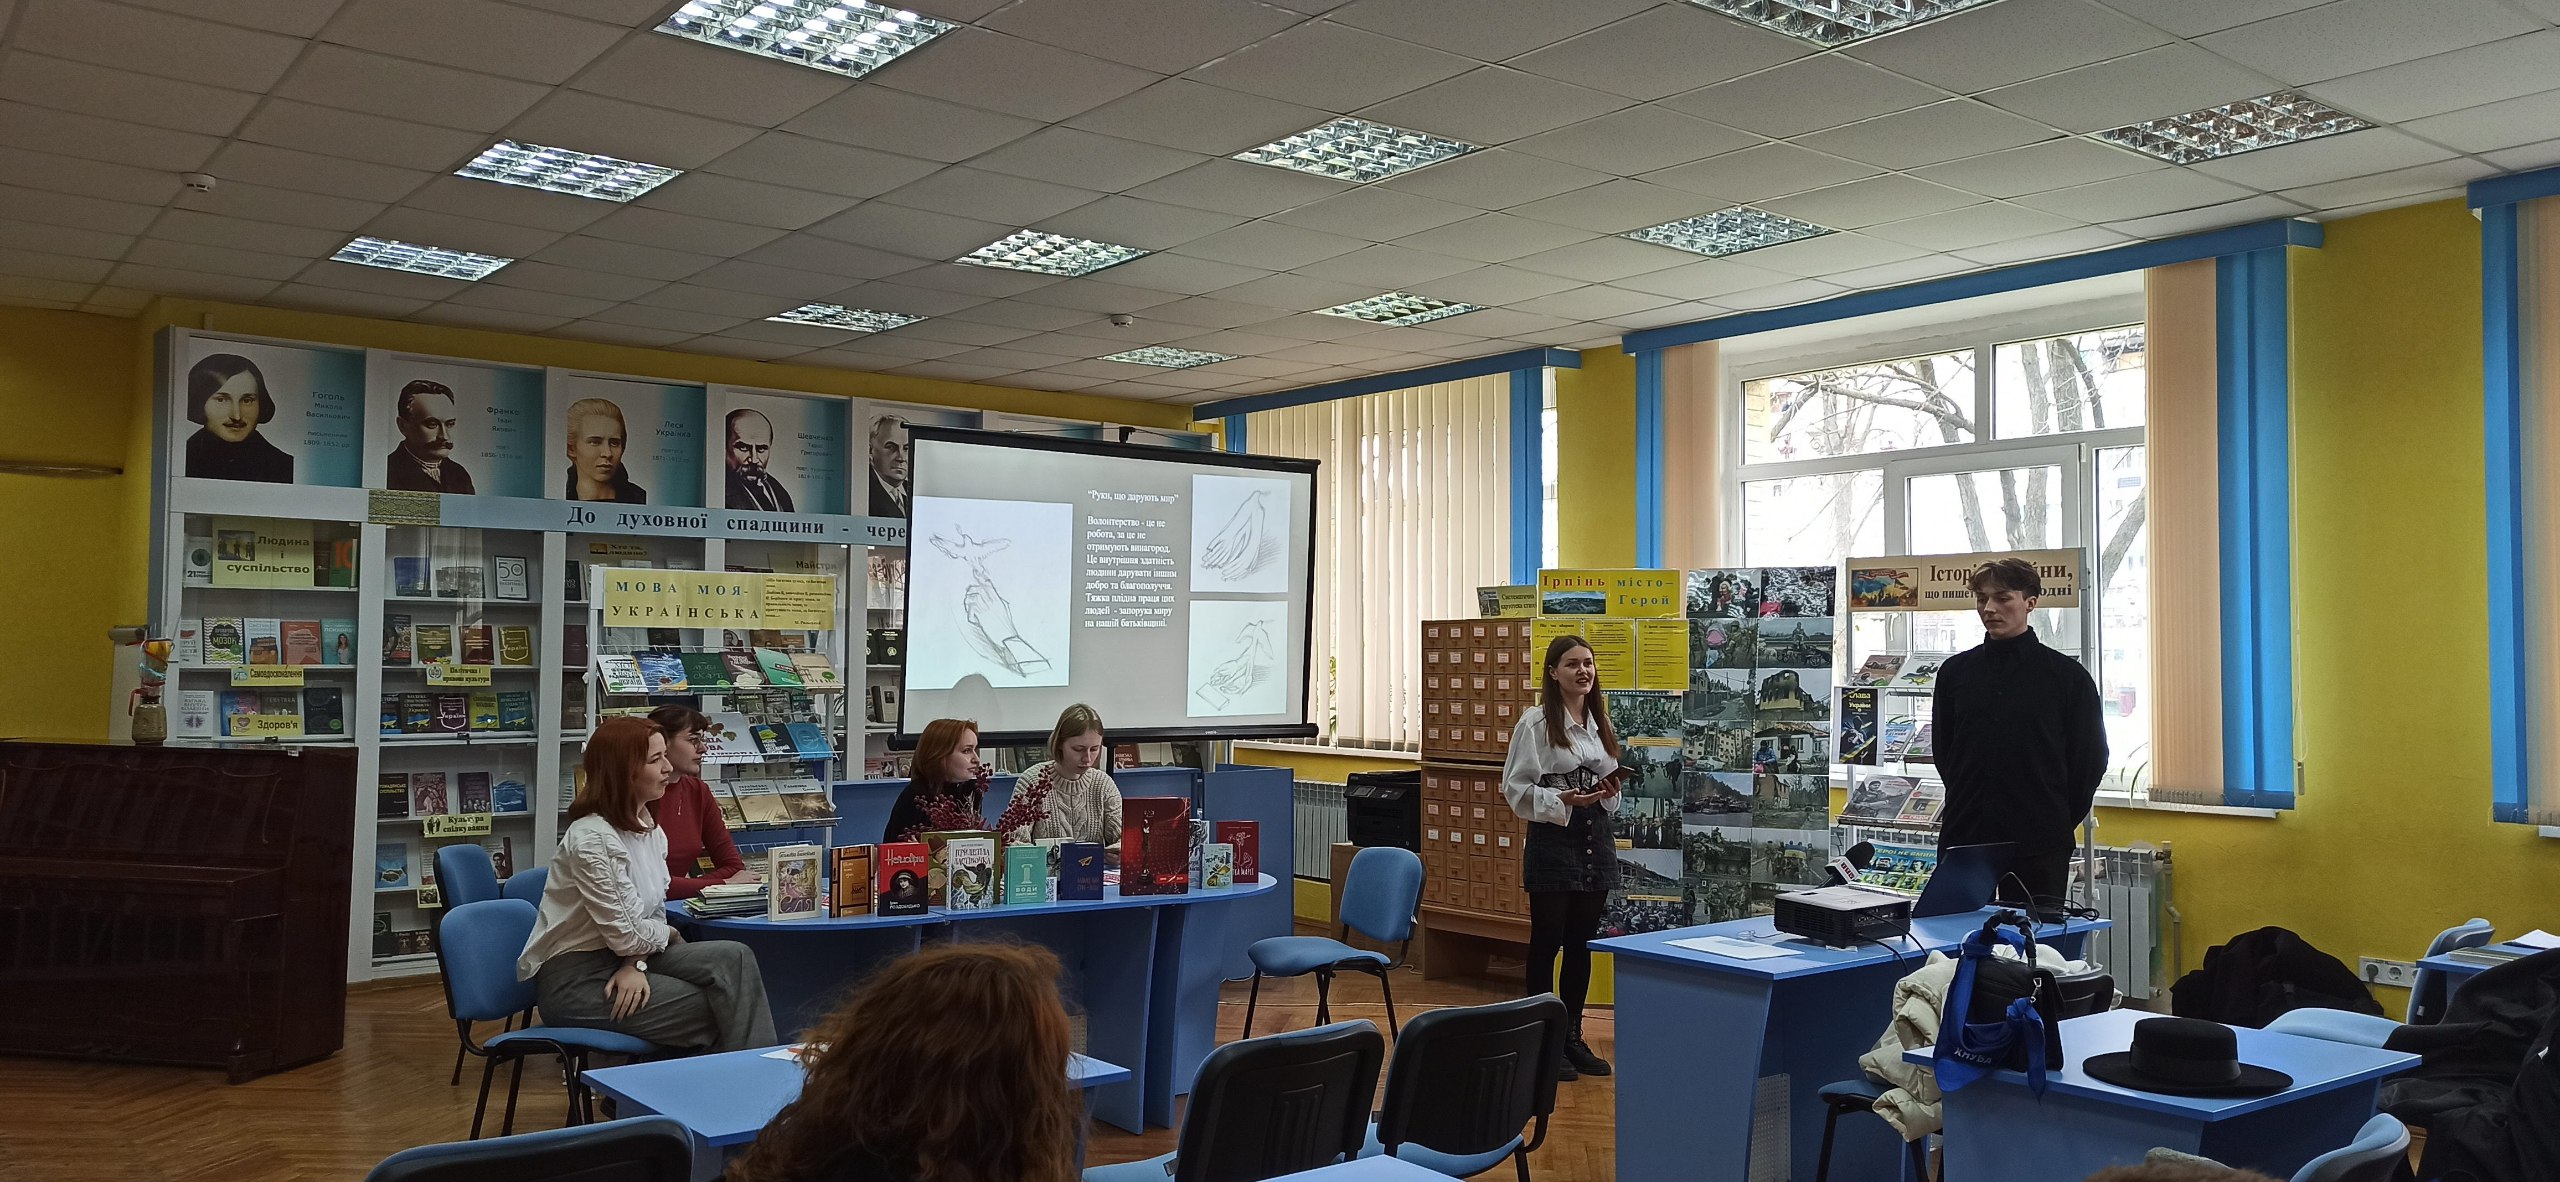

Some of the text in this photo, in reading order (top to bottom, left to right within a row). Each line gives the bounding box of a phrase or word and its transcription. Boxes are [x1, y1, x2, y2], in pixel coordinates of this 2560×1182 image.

[312, 391, 345, 401] Гоголь
[486, 406, 521, 416] Франко
[664, 420, 684, 428] Леся
[656, 429, 691, 438] Українка
[797, 432, 834, 442] Шевченко
[1114, 494, 1126, 503] що
[1127, 493, 1159, 504] дарують
[567, 506, 596, 526] До
[616, 511, 707, 530] духовної
[726, 517, 824, 534] спадщини
[866, 526, 906, 541] чере
[1087, 516, 1140, 528] Волонтерство
[1146, 520, 1156, 529] це
[1156, 520, 1166, 528] не
[1087, 529, 1147, 540] робота, за це не
[257, 535, 310, 547] Людина
[1086, 543, 1171, 555] отримують винагород.
[1086, 554, 1175, 566] Це внутрішня здатність
[226, 563, 310, 575] суспільство
[1085, 568, 1177, 580] людини дарувати іншим
[1929, 564, 1977, 587] Істор
[615, 581, 749, 596] МОВА МОЯ-
[1085, 580, 1173, 592] добро та благополуччя.
[1543, 575, 1606, 590] Ірпінь
[1924, 583, 2072, 601] що пишет одні
[1084, 592, 1110, 603] Тяжка
[1138, 595, 1160, 605] праця
[1619, 594, 1669, 608] Герой
[612, 604, 760, 620] УКРАЇНСЬКА
[1084, 606, 1110, 616] людей
[1119, 607, 1153, 617] запорука
[1153, 607, 1173, 618] миру
[1084, 618, 1094, 627] на
[1095, 618, 1119, 628] нашій
[212, 636, 238, 645] МОЗОК
[465, 676, 490, 684] культура
[257, 719, 299, 731] Здоров'я
[1953, 1047, 1993, 1065] КНУБА
